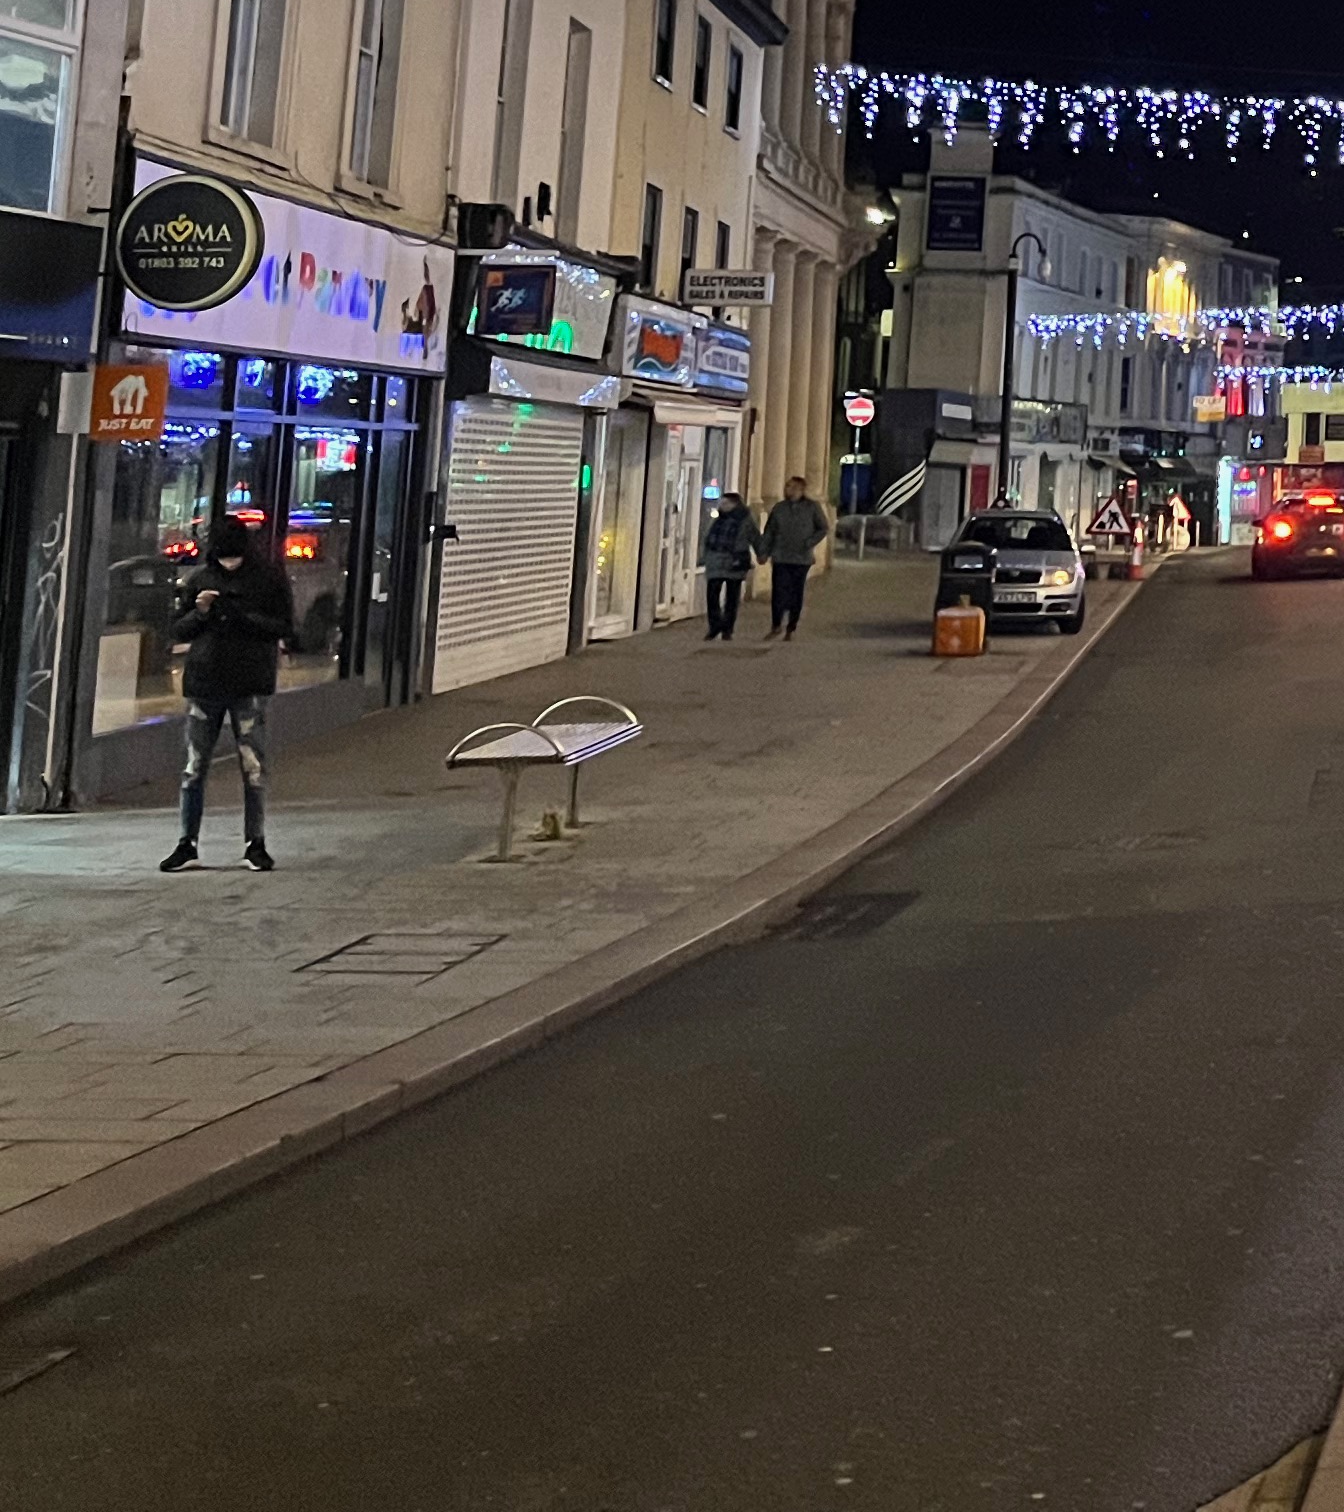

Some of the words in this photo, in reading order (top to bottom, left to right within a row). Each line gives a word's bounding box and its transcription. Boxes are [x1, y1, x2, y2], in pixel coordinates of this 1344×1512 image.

[203, 257, 225, 268] 743
[689, 275, 765, 287] ELECTRONICS
[688, 289, 716, 299] SALES
[727, 290, 765, 300] REPAIRS
[98, 419, 127, 431] JUST
[129, 418, 155, 430] EAT
